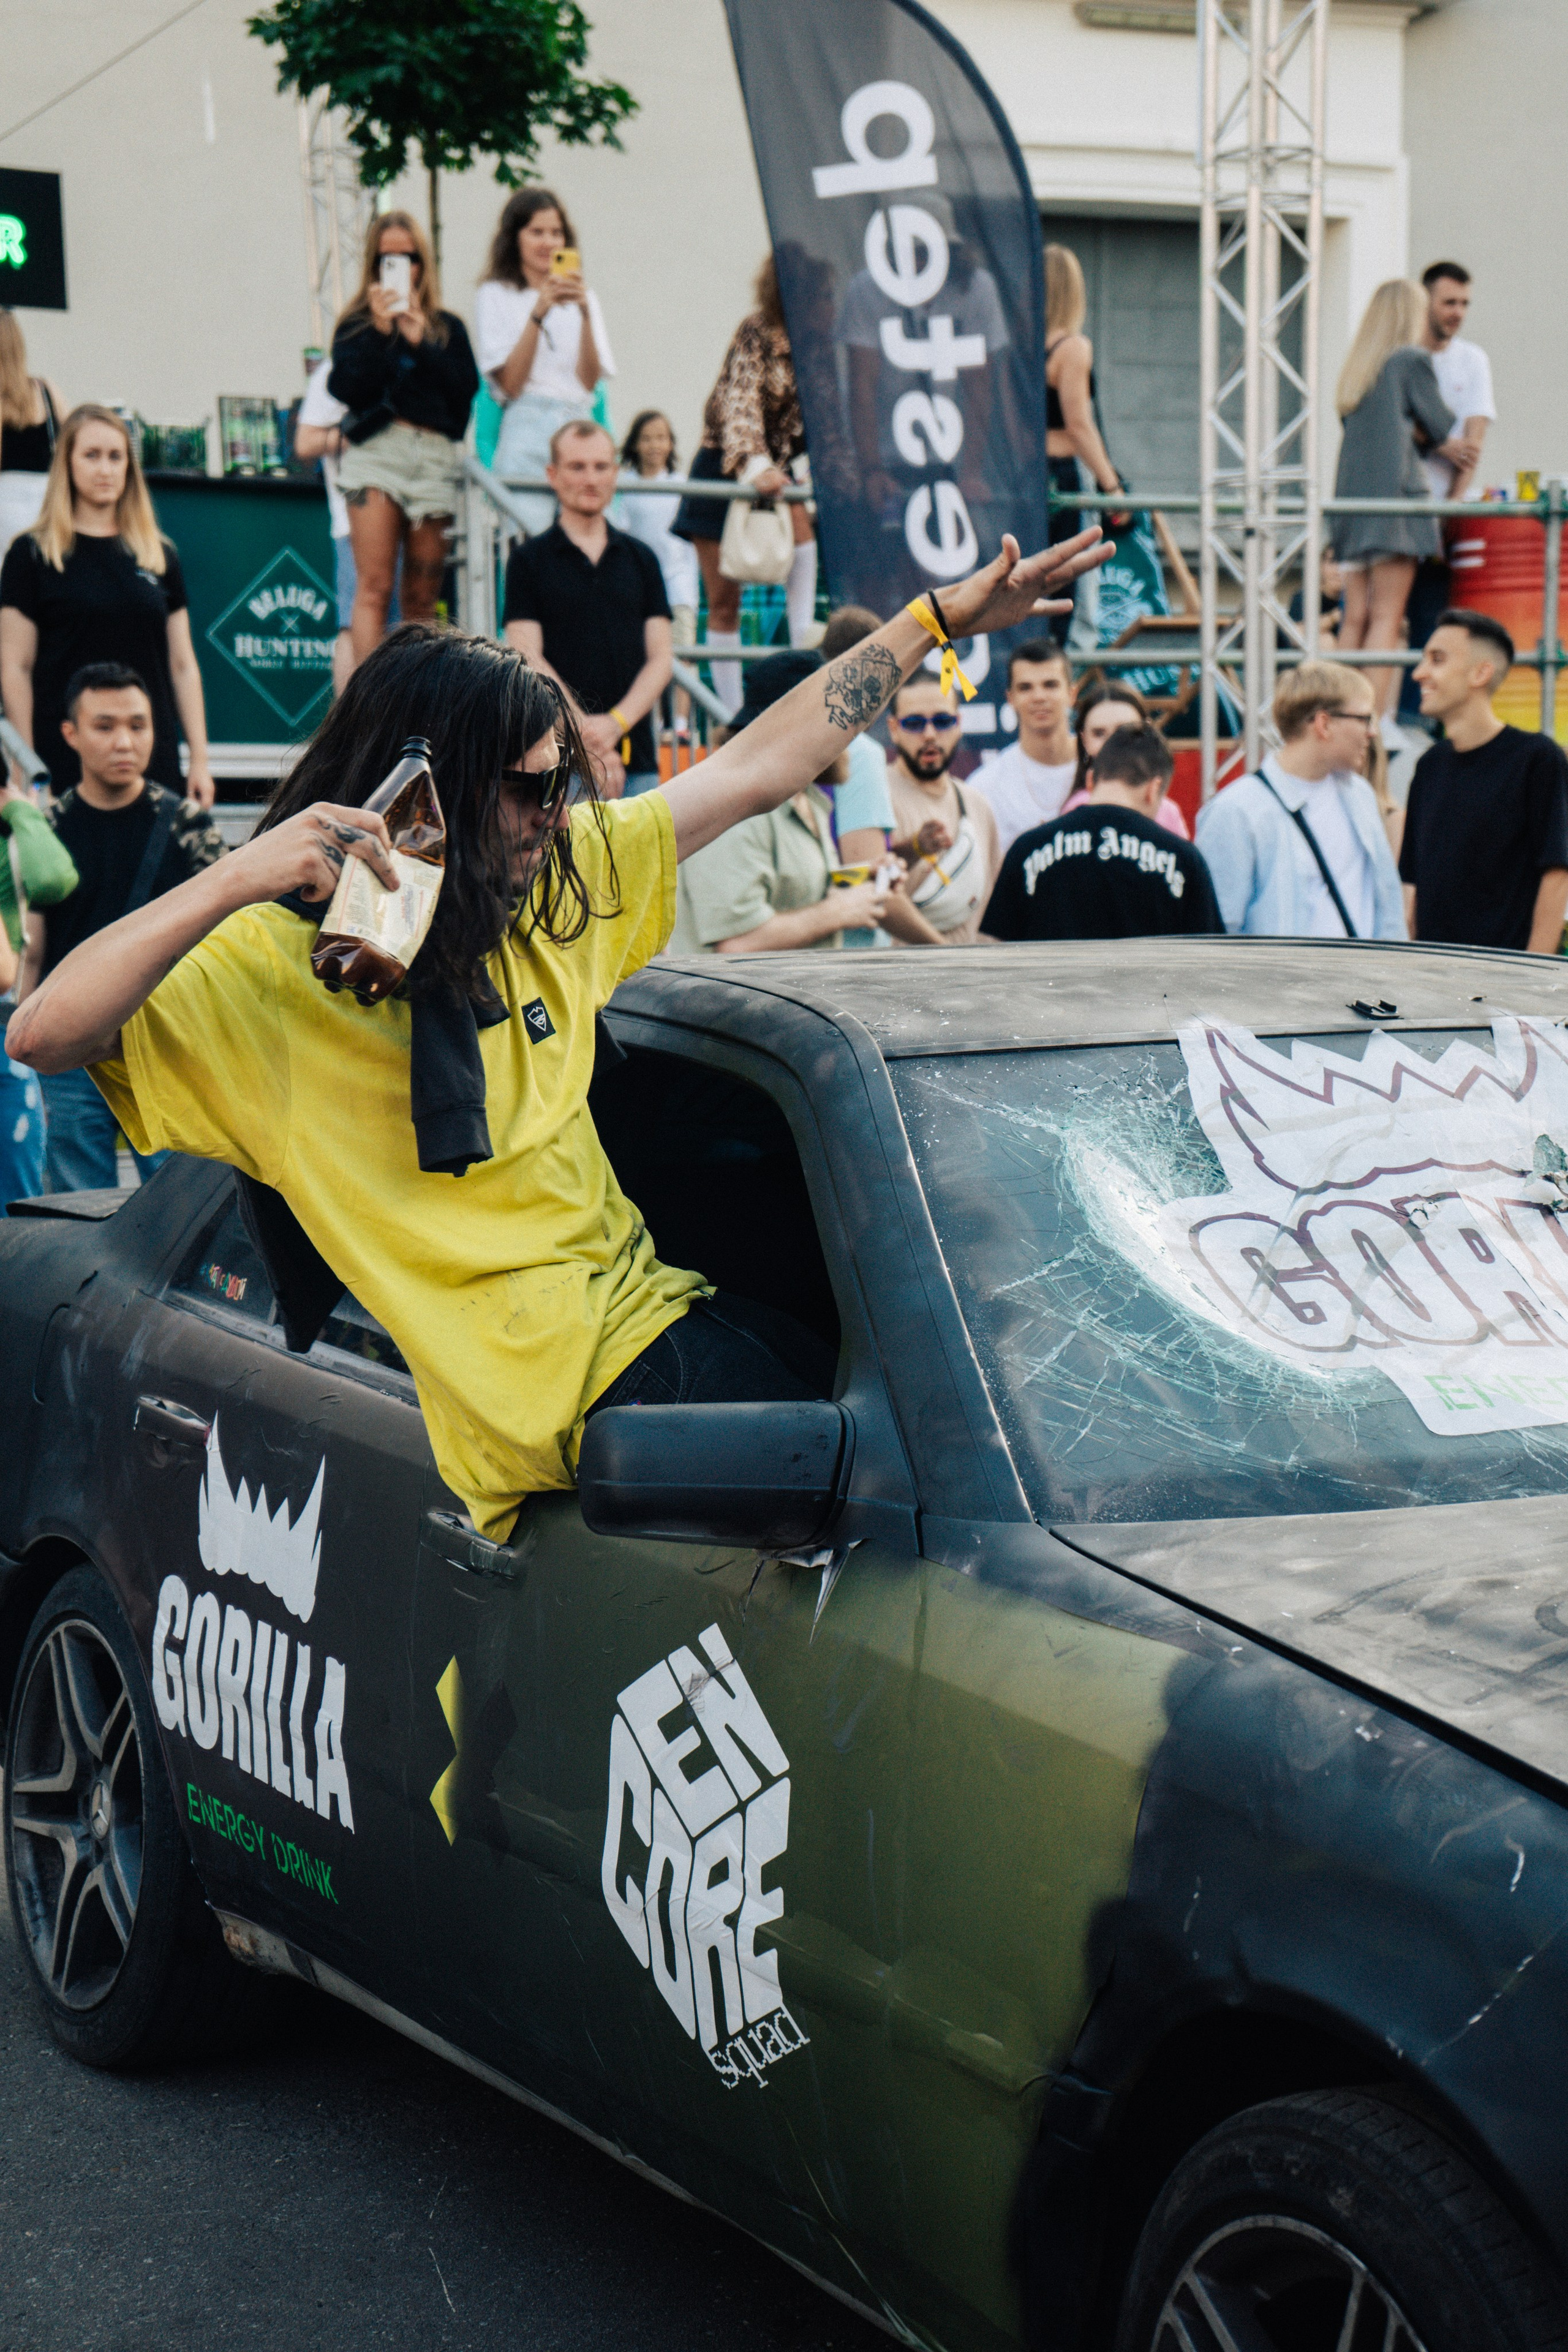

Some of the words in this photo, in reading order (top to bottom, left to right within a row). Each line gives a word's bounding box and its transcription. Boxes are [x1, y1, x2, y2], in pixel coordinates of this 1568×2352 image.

[235, 633, 336, 658] HUNTIN
[1097, 826, 1185, 899] Angels
[152, 1575, 355, 1834] GORILLA
[187, 1782, 266, 1861] ENERGY
[271, 1832, 339, 1905] DRINK
[706, 2003, 811, 2090] squad
